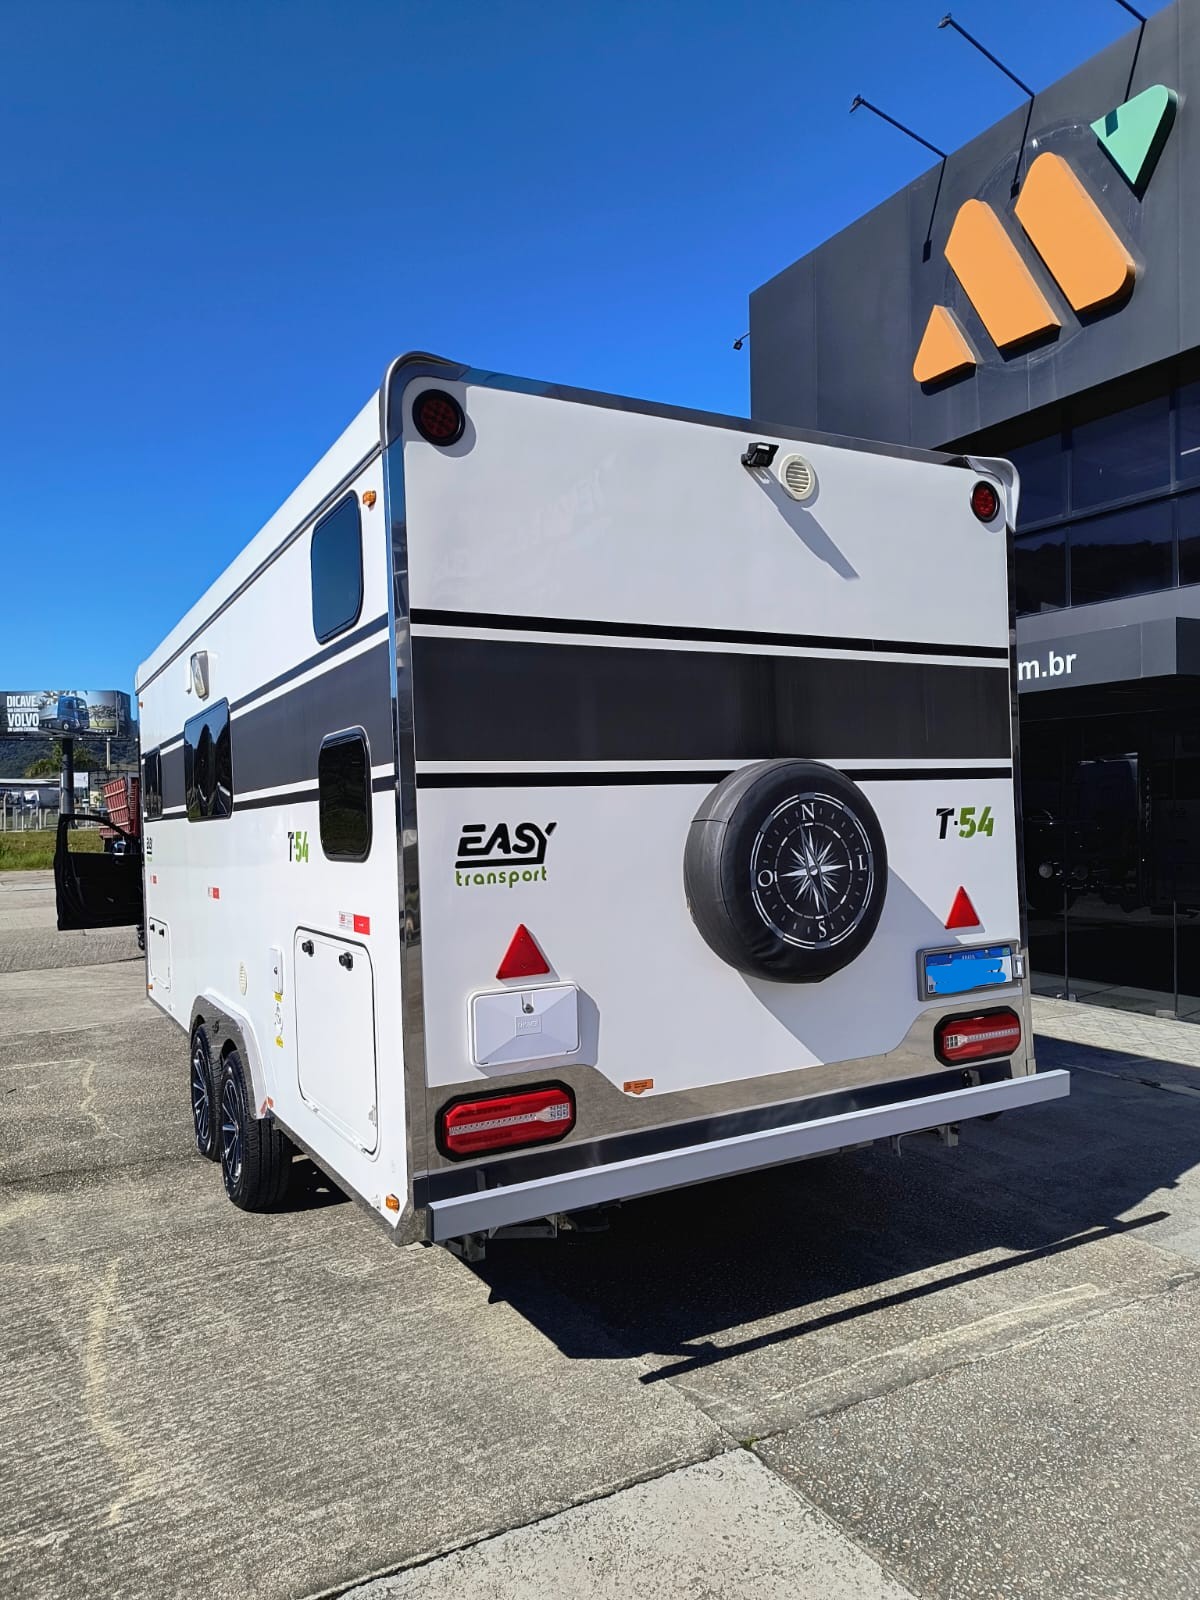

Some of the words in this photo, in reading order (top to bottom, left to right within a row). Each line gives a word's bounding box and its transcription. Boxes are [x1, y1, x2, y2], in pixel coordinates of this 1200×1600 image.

[1018, 651, 1077, 681] m.br
[7, 695, 38, 707] DICAVE
[7, 713, 39, 727] VOLVO
[801, 802, 814, 820] N
[455, 822, 557, 868] EASY
[455, 865, 547, 888] transport
[757, 869, 774, 887] O
[818, 920, 828, 939] S
